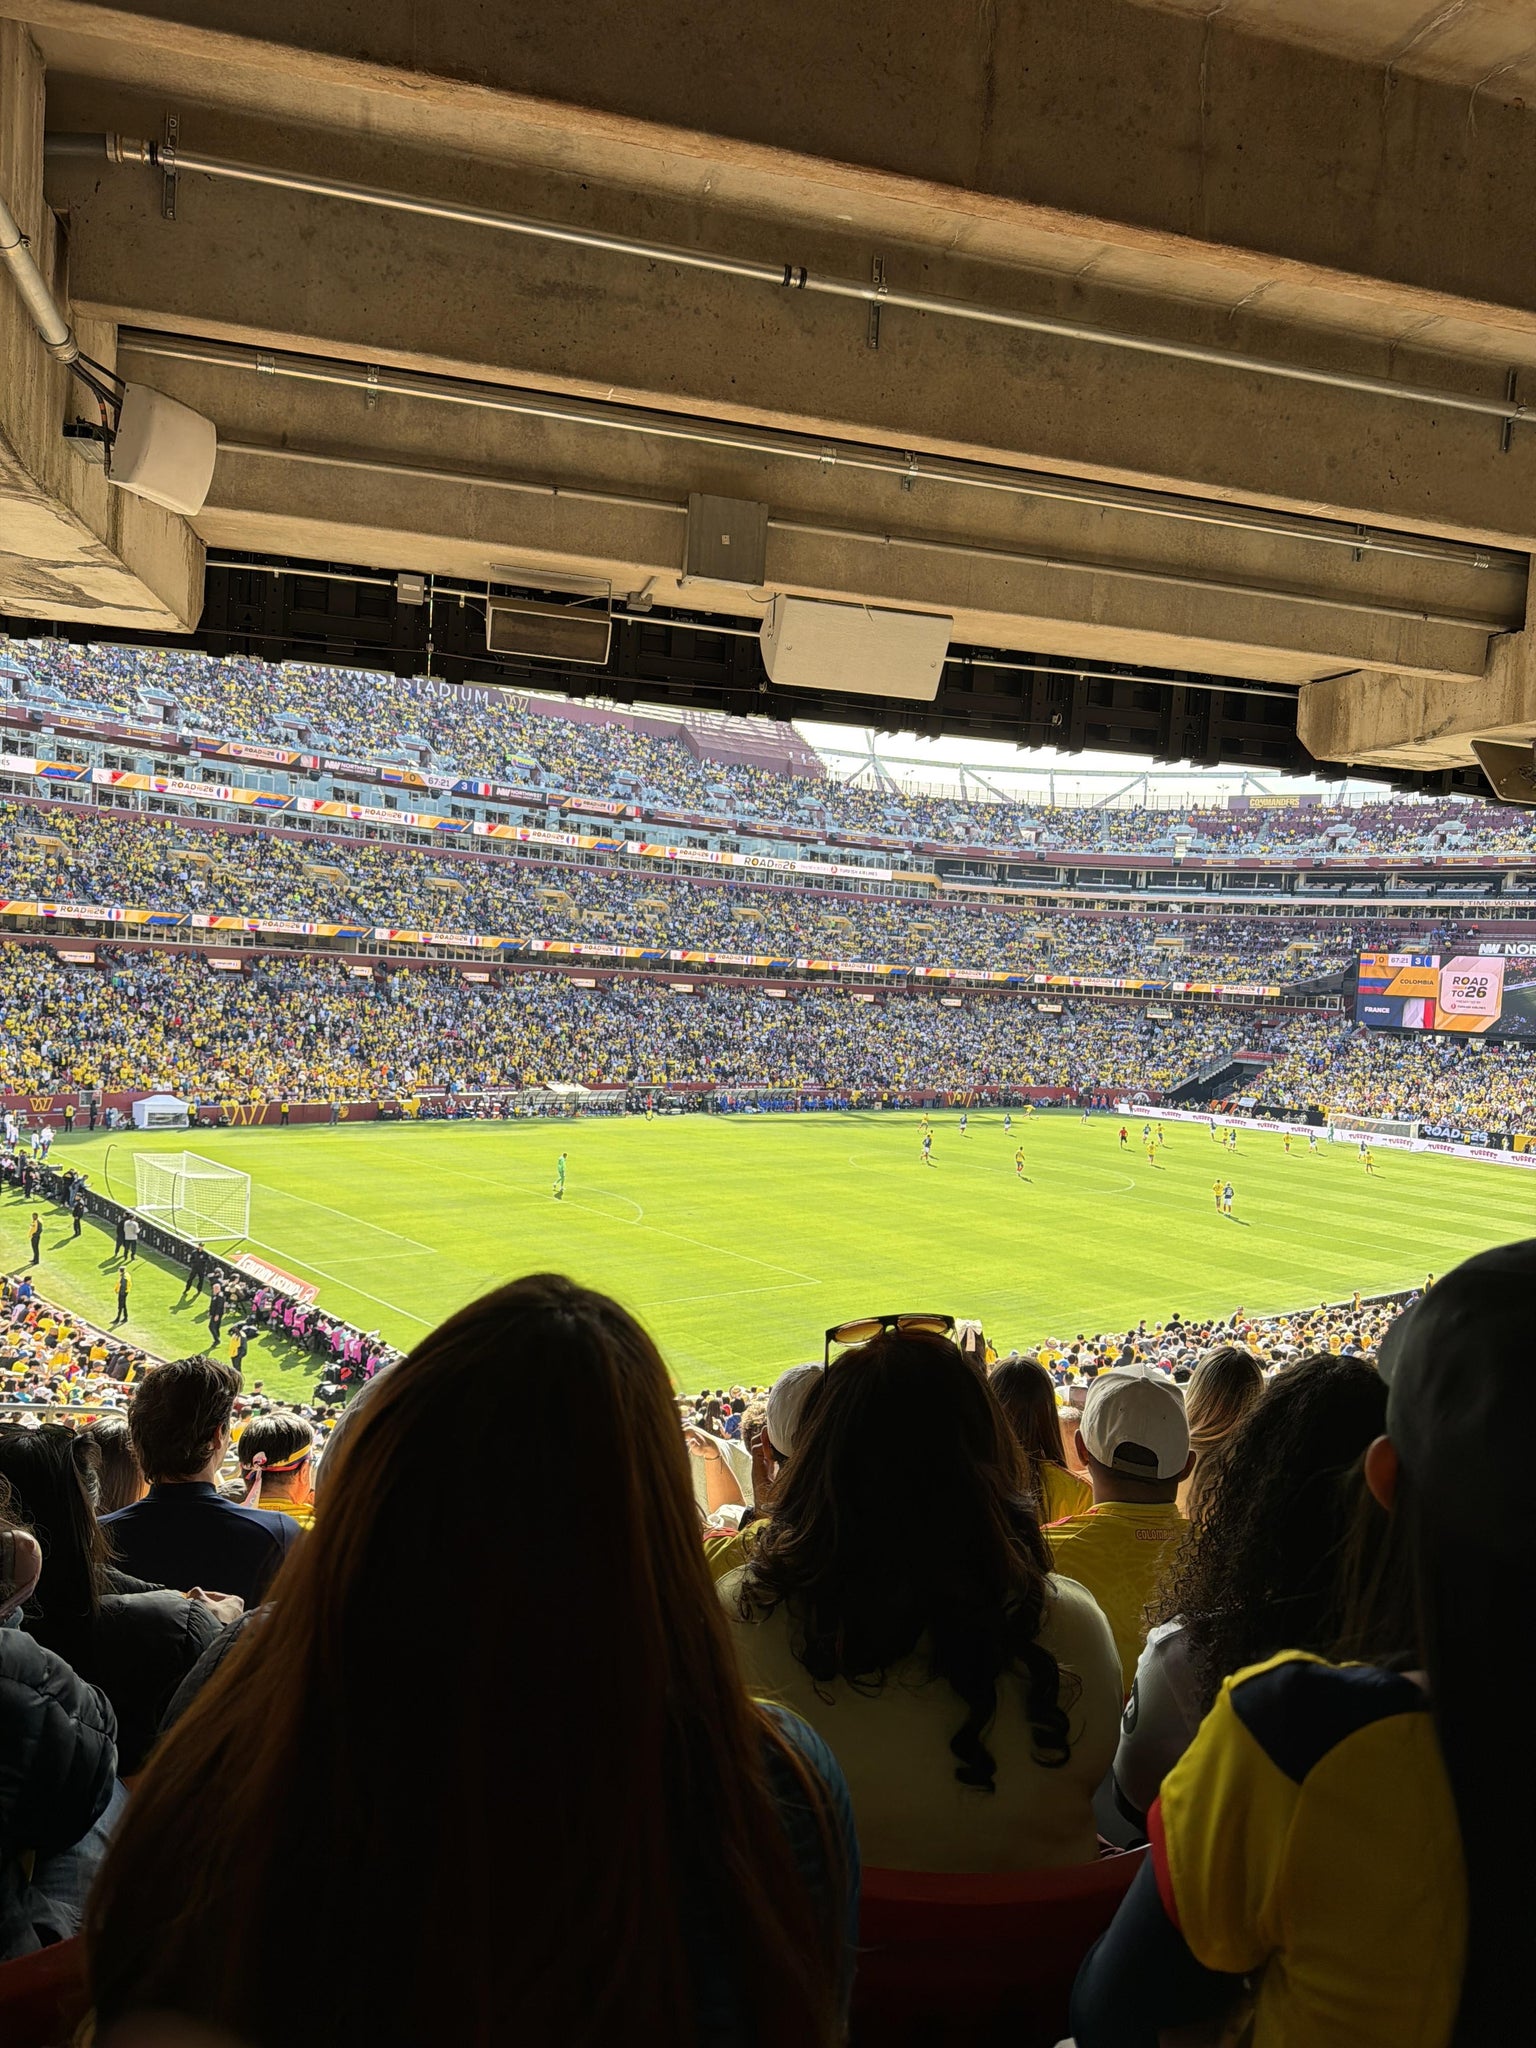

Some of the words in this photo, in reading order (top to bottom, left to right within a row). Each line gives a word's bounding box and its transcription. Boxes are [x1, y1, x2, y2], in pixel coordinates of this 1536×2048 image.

[402, 677, 489, 709] STADIUM
[340, 762, 377, 773] NORTHWEST
[171, 780, 196, 790] ROAD
[203, 785, 214, 793] 26
[409, 774, 416, 782] 0
[428, 777, 450, 787] 67:21
[461, 781, 468, 791] 3
[1249, 797, 1300, 807] COMMANDERS
[365, 808, 387, 817] ROAD
[532, 831, 551, 839] ROAD
[744, 856, 774, 868] ROAD
[782, 861, 796, 870] 26
[60, 905, 87, 914] ROAD
[94, 907, 105, 915] 26
[262, 920, 284, 928] ROAD
[1378, 956, 1384, 964] 0
[1415, 957, 1421, 965] 3
[1452, 976, 1489, 986] ROAD
[1364, 1006, 1390, 1014] FRANCE
[1424, 1125, 1461, 1138] ROAD
